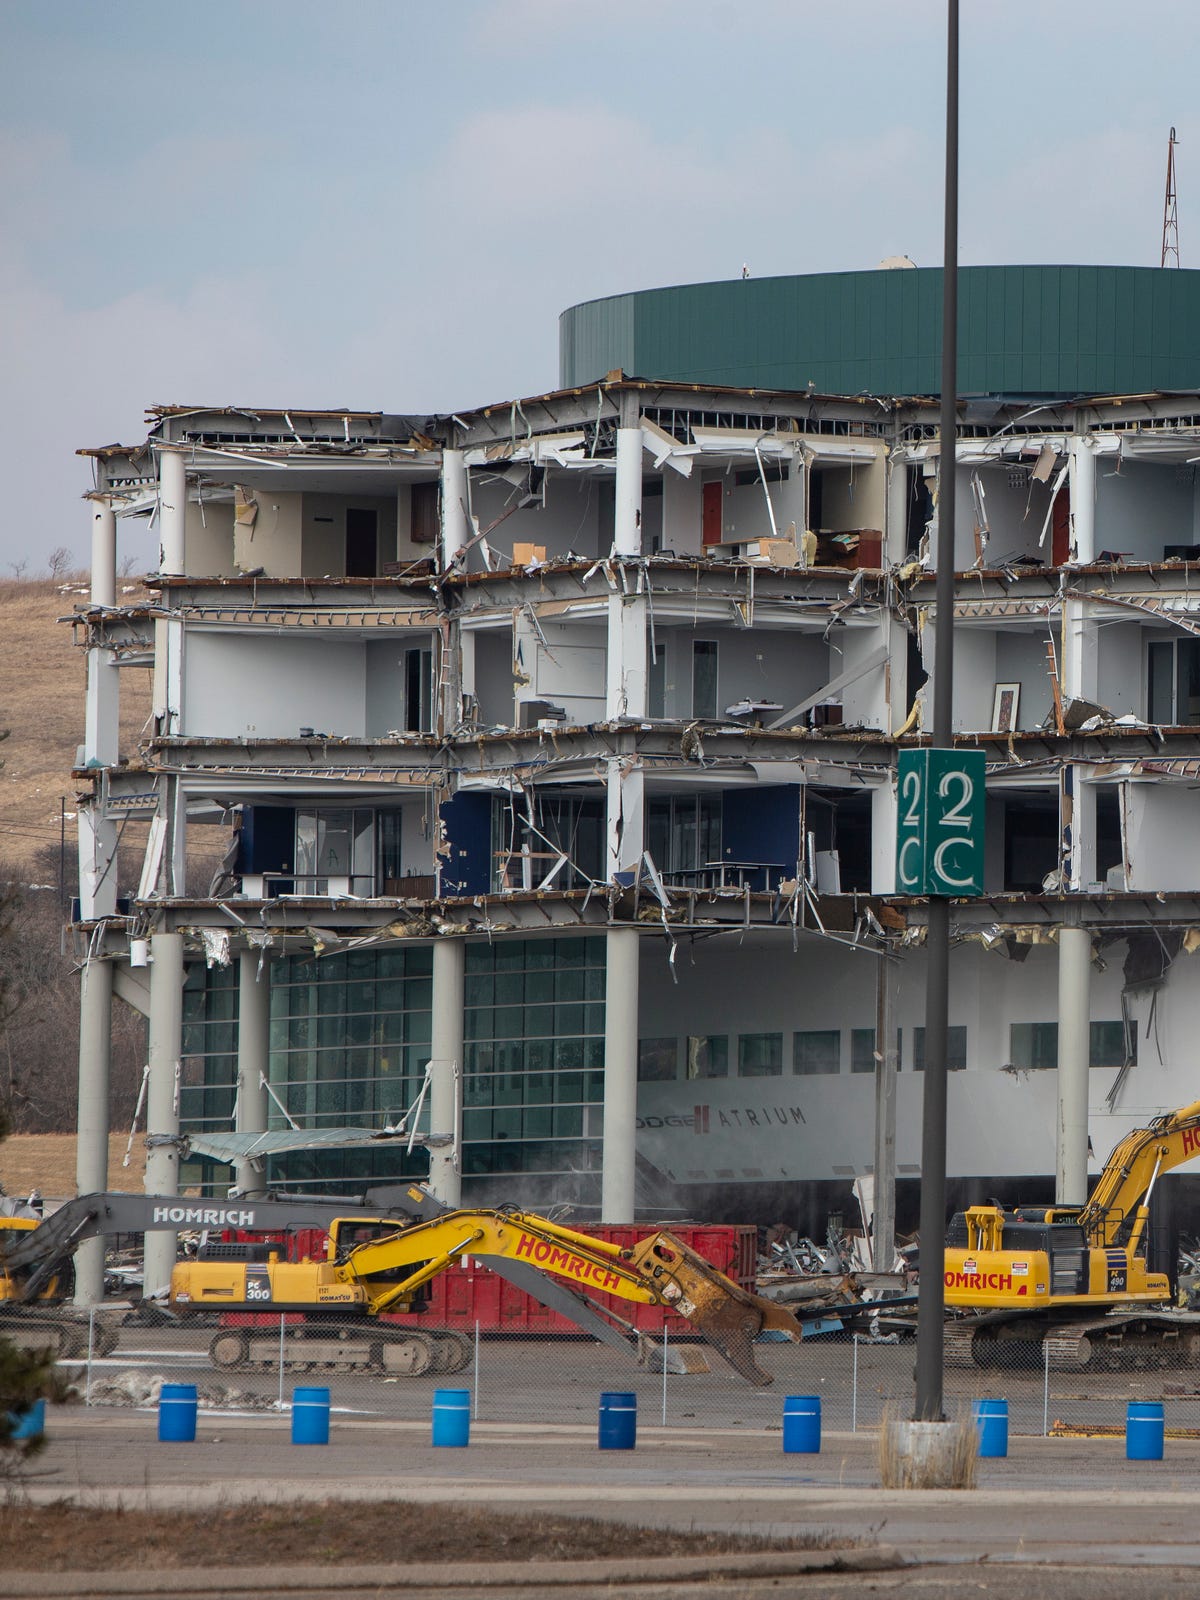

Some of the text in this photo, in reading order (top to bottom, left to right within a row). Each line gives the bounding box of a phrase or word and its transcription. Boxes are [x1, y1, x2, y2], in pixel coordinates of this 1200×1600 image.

[903, 771, 921, 827] 2
[938, 771, 974, 828] 2
[899, 836, 921, 885] C
[934, 837, 974, 887] C
[636, 1106, 808, 1129] ODGE ATRIUM
[153, 1207, 254, 1227] HOMRICH
[515, 1233, 621, 1291] HOMRICH
[247, 1281, 260, 1290] PC
[944, 1271, 1013, 1291] OMRICH
[1110, 1277, 1124, 1286] 490
[246, 1289, 270, 1300] 300
